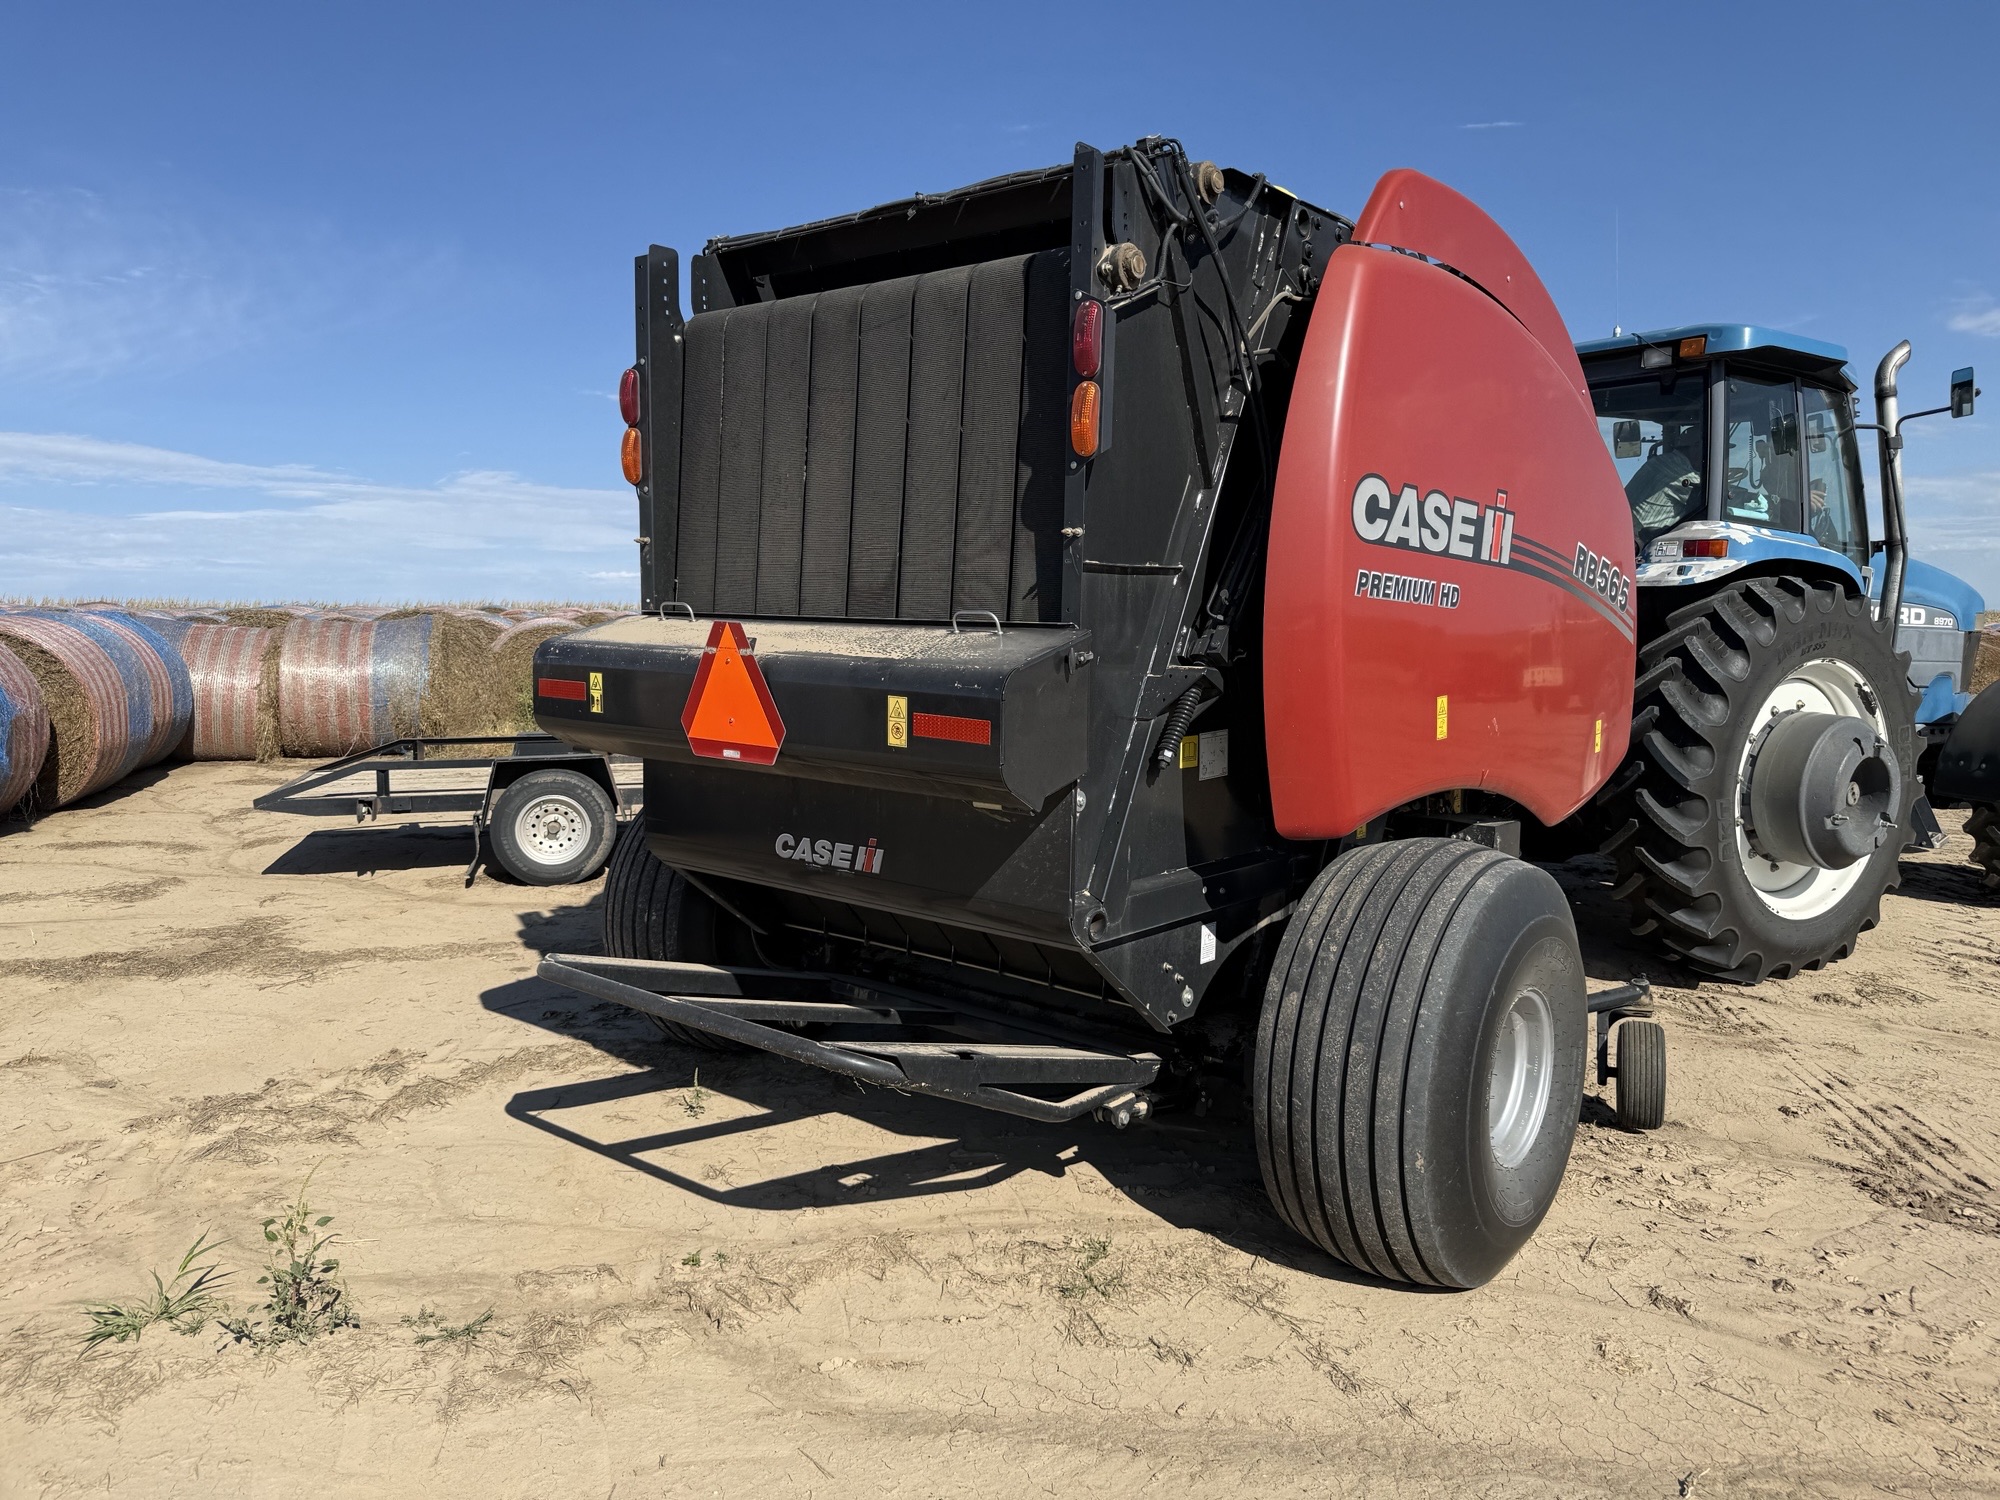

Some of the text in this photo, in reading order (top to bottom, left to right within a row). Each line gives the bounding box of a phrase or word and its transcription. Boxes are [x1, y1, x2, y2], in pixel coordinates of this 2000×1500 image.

[1351, 473, 1479, 558] CASE
[1354, 569, 1460, 609] PREMIUM HD
[1572, 541, 1631, 613] RB565
[1871, 606, 1953, 626] RD 8970
[775, 833, 854, 869] CASE
